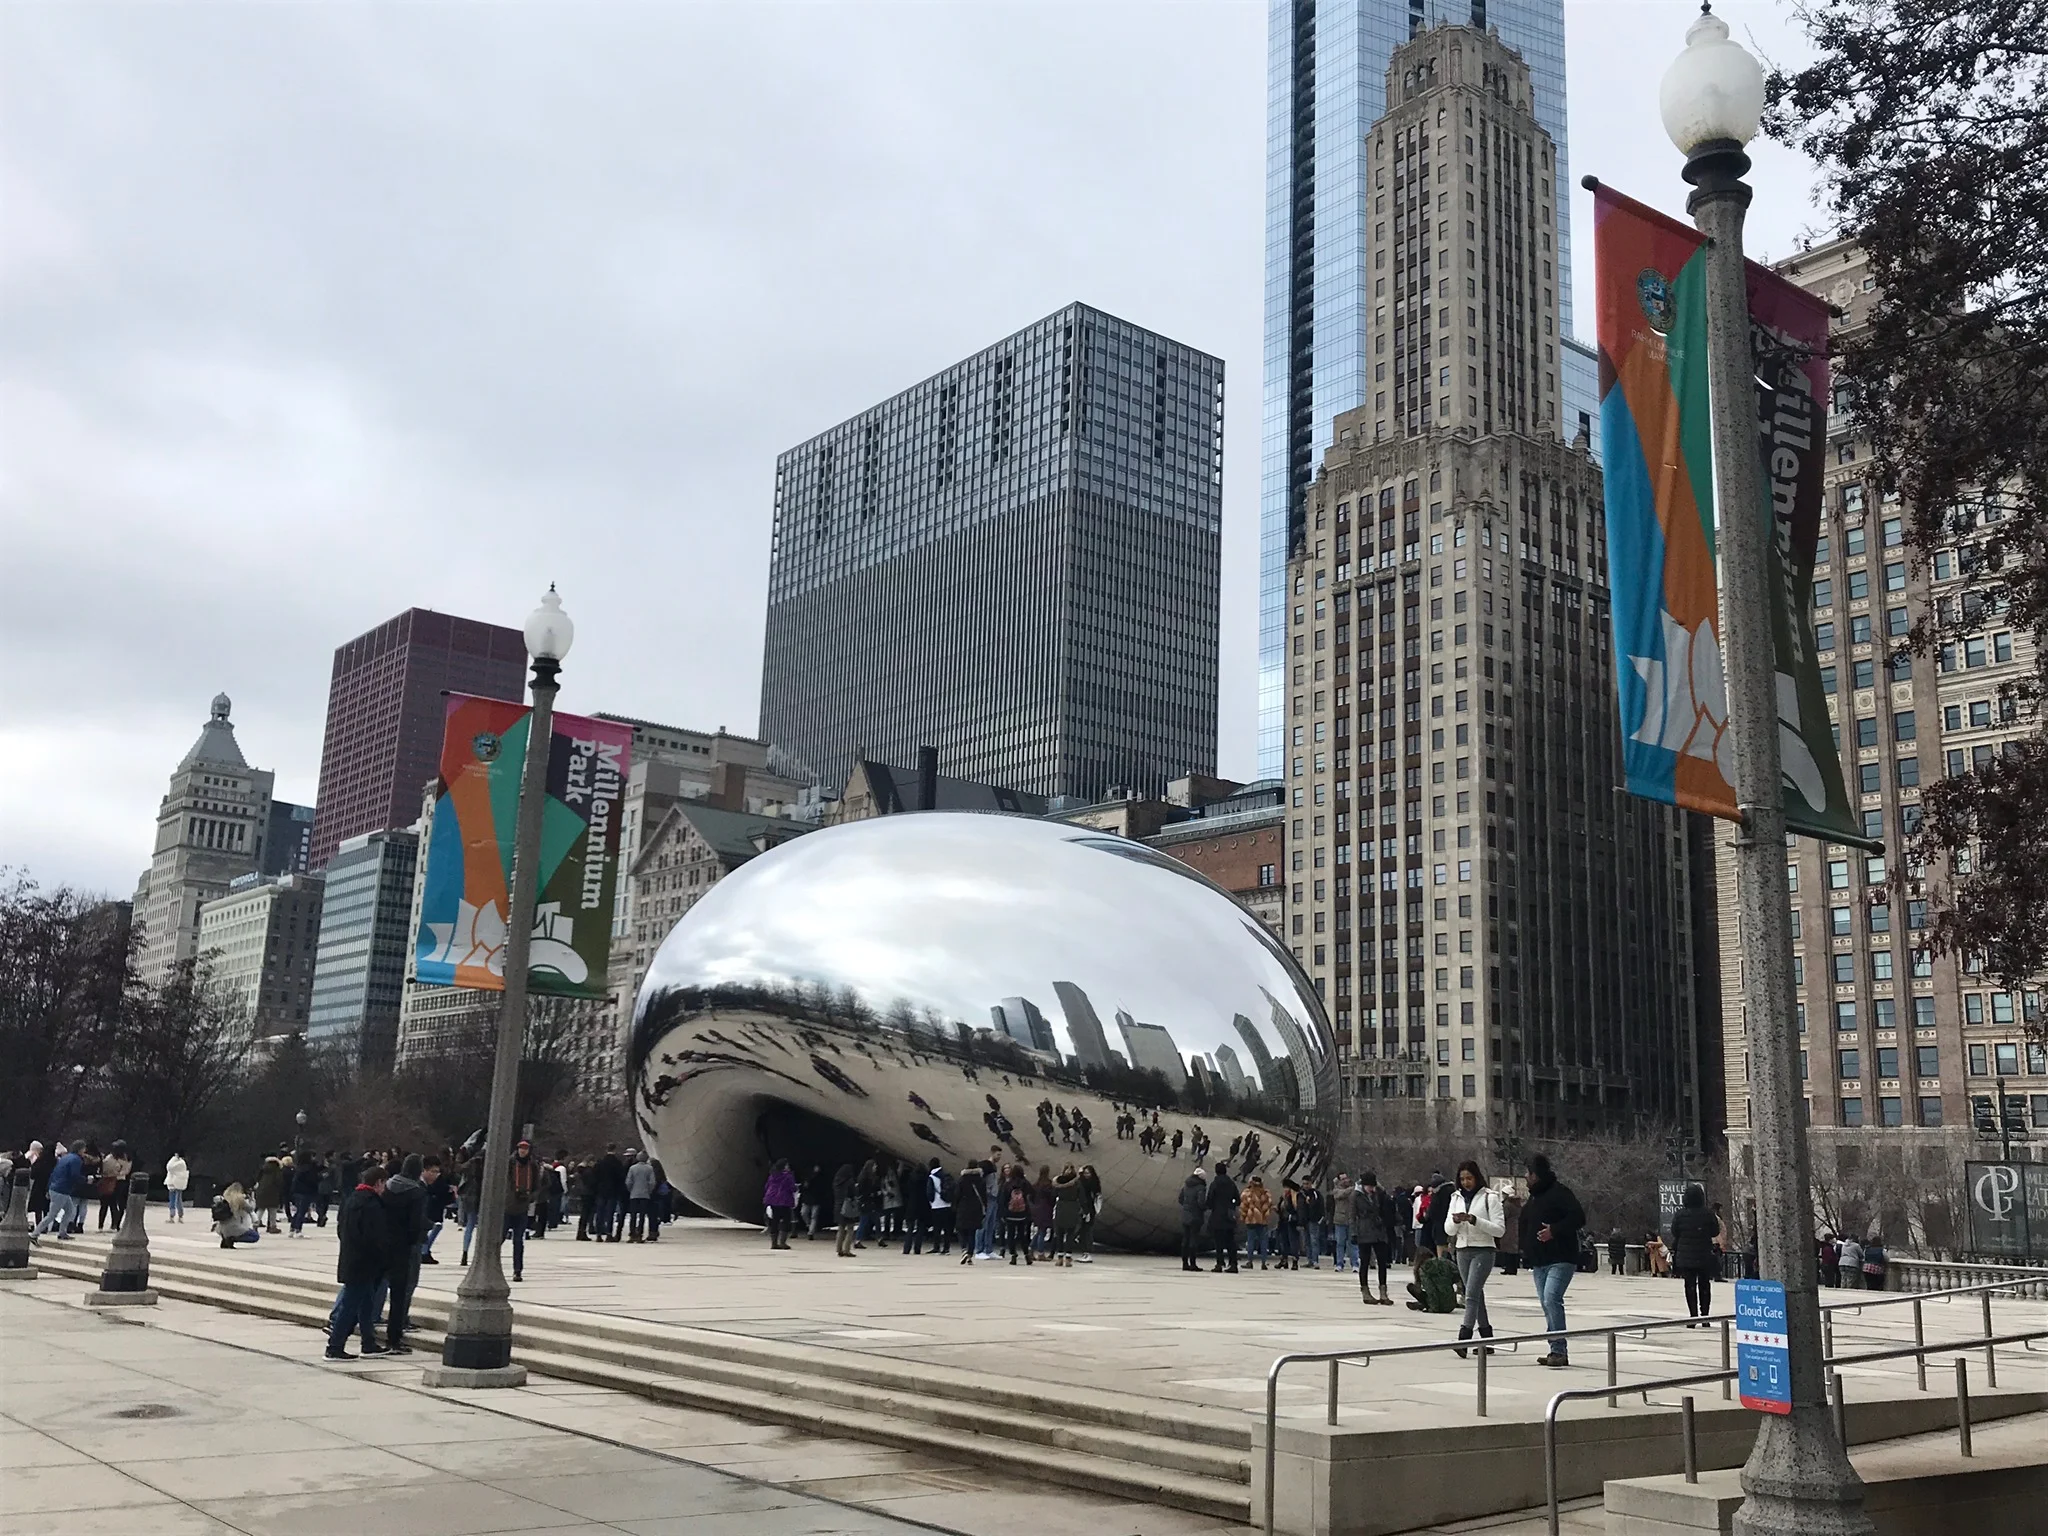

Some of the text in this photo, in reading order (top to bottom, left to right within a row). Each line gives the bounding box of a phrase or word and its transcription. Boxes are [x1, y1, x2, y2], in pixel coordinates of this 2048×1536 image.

[565, 736, 597, 804] Park
[579, 740, 623, 910] Millennium
[1659, 1184, 1686, 1193] SMILE
[1660, 1193, 1685, 1205] EAT
[1660, 1205, 1686, 1214] ENJO
[1752, 1295, 1767, 1305] Hear
[1738, 1303, 1783, 1319] Cloud Gate
[1753, 1318, 1768, 1328] here
